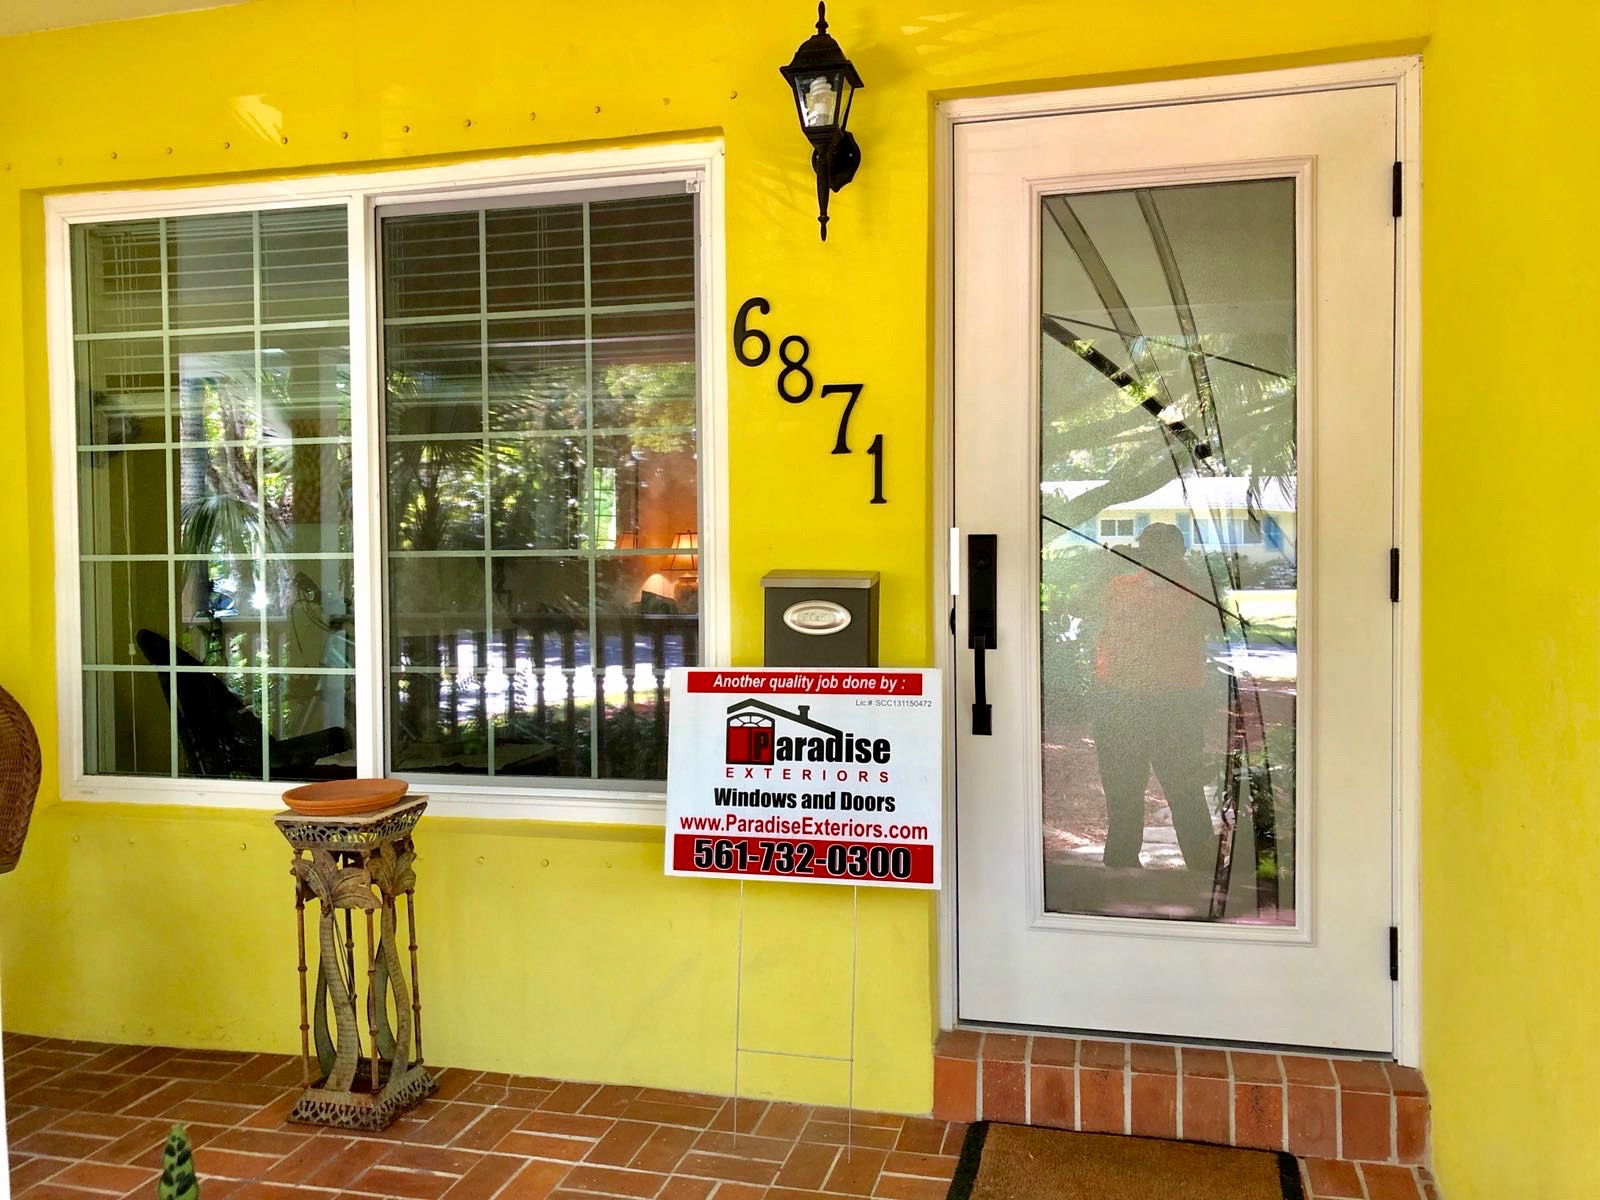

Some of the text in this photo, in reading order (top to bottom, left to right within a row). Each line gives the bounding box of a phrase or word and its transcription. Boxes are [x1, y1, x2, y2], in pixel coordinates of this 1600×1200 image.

[733, 297, 888, 504] 6871
[713, 673, 766, 688] Another
[769, 675, 814, 692] quality
[815, 675, 839, 692] job
[842, 675, 877, 689] done
[879, 675, 897, 693] by
[754, 732, 891, 764] Paradise
[725, 767, 889, 783] EXTERIORS
[714, 787, 896, 812] Windows and Doors
[680, 814, 928, 840] www.ParadiseExteriors.com
[693, 838, 912, 880] 561-732-0300
